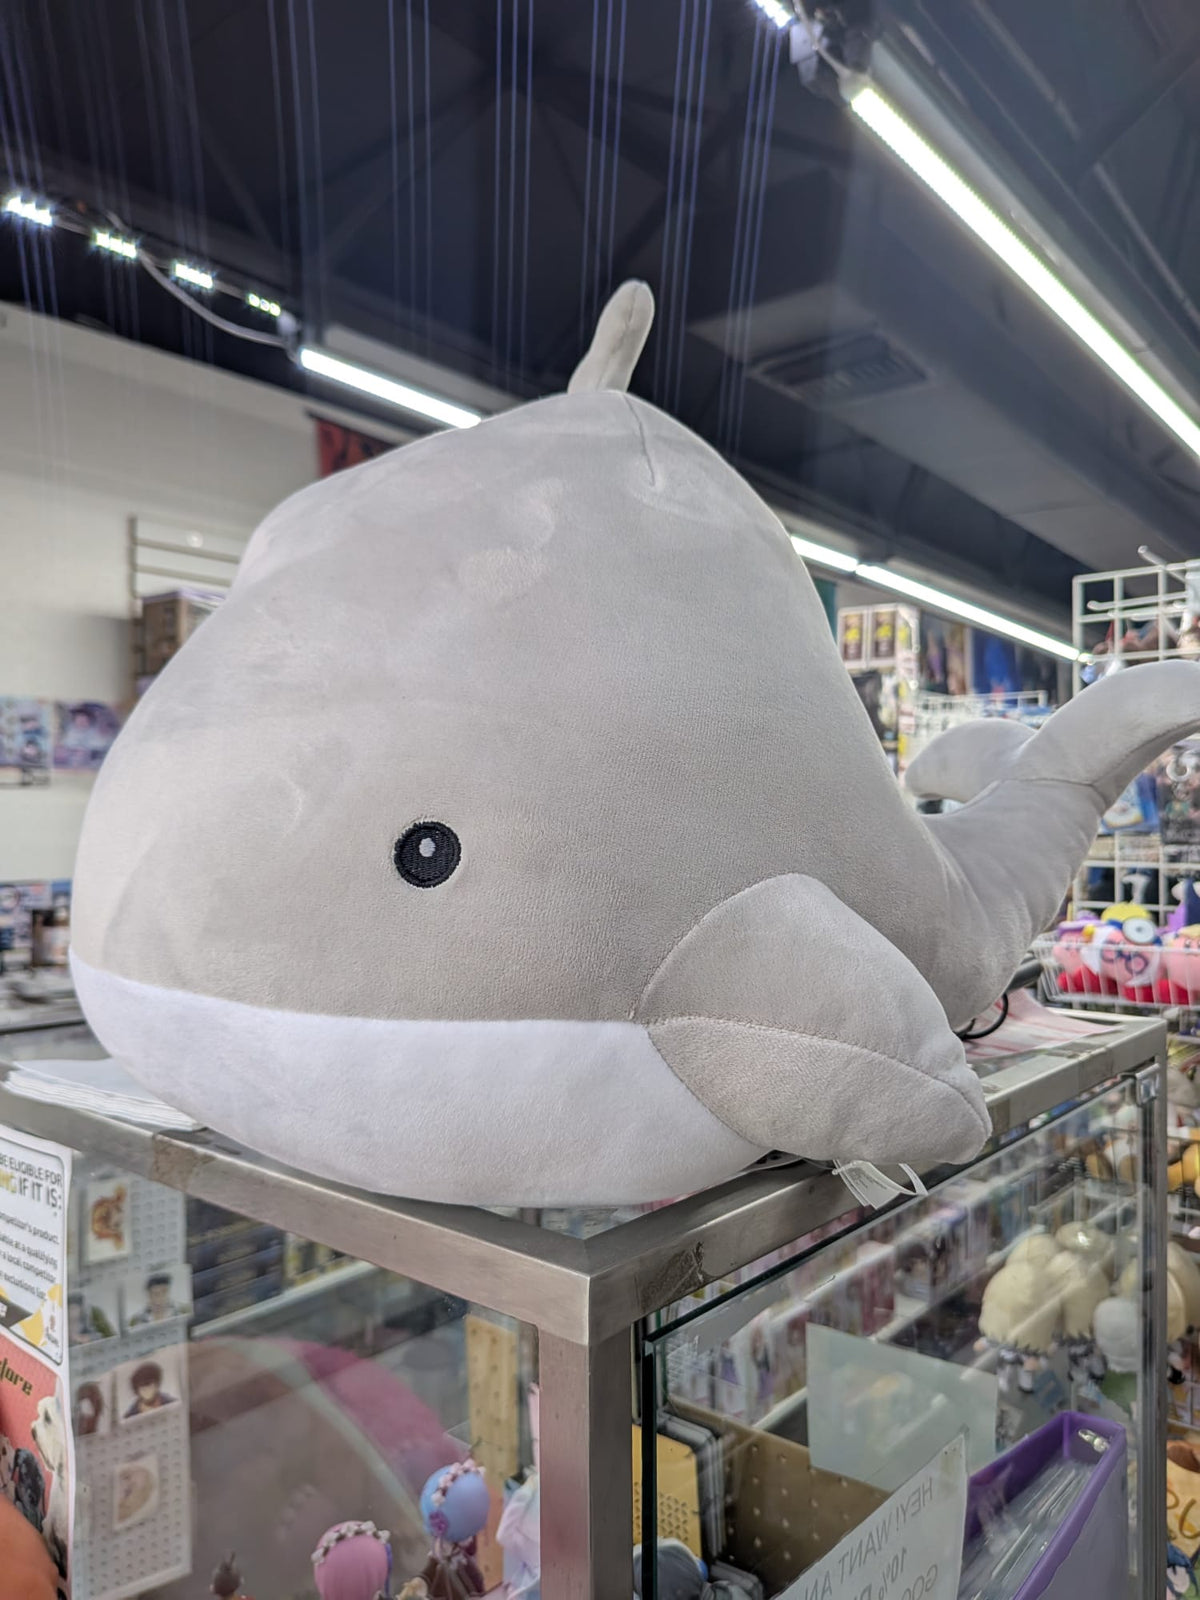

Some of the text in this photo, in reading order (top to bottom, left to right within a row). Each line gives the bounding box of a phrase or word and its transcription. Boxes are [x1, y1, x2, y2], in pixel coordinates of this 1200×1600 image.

[9, 1157, 44, 1181] ELIGIBLE
[44, 1169, 62, 1188] FOR
[19, 1176, 28, 1197] IF
[32, 1180, 43, 1202] IT
[46, 1185, 62, 1210] IS:
